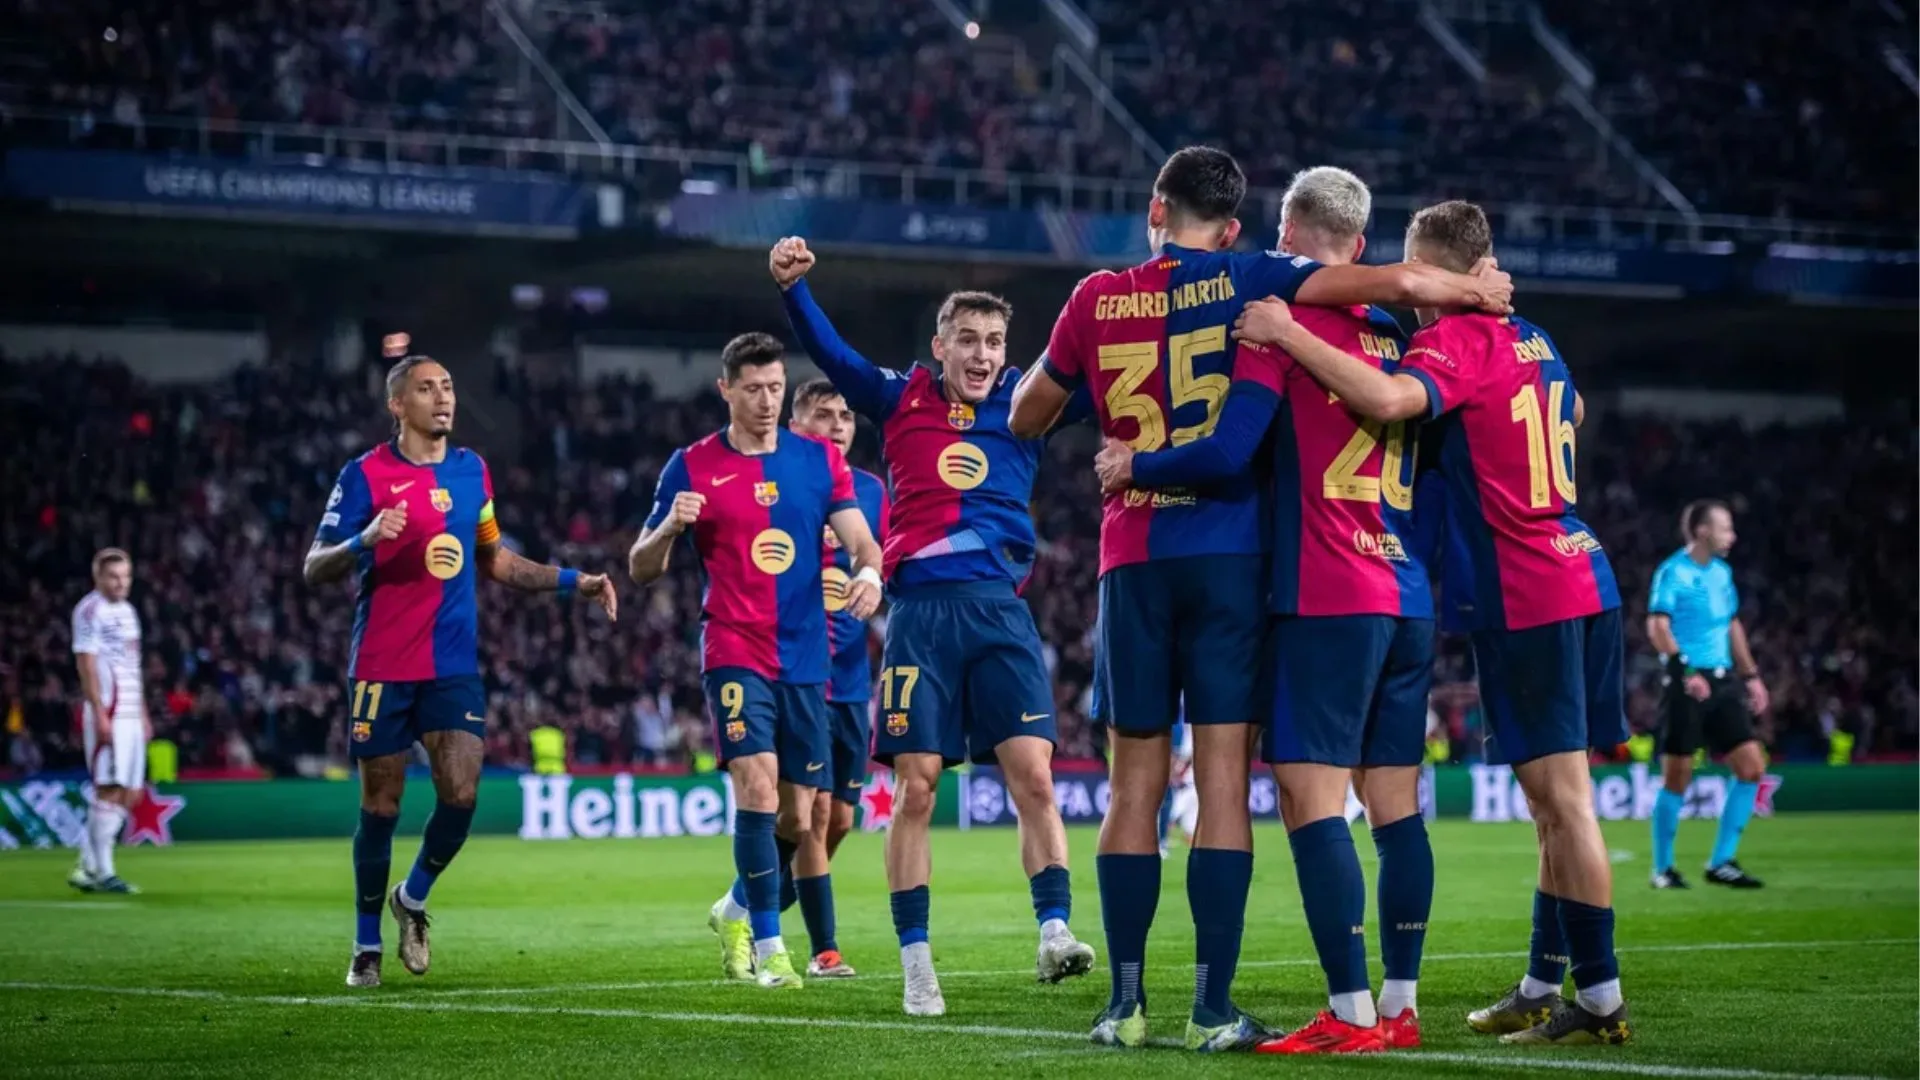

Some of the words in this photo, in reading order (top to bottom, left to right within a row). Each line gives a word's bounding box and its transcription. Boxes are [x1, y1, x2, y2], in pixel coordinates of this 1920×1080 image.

[1095, 291, 1169, 320] GERARD
[1359, 331, 1400, 361] OLMO
[1098, 325, 1230, 452] 35
[1510, 381, 1576, 509] 16
[352, 681, 383, 720] 11
[720, 682, 745, 718] 9
[881, 666, 920, 709] 17
[518, 772, 736, 840] Heine
